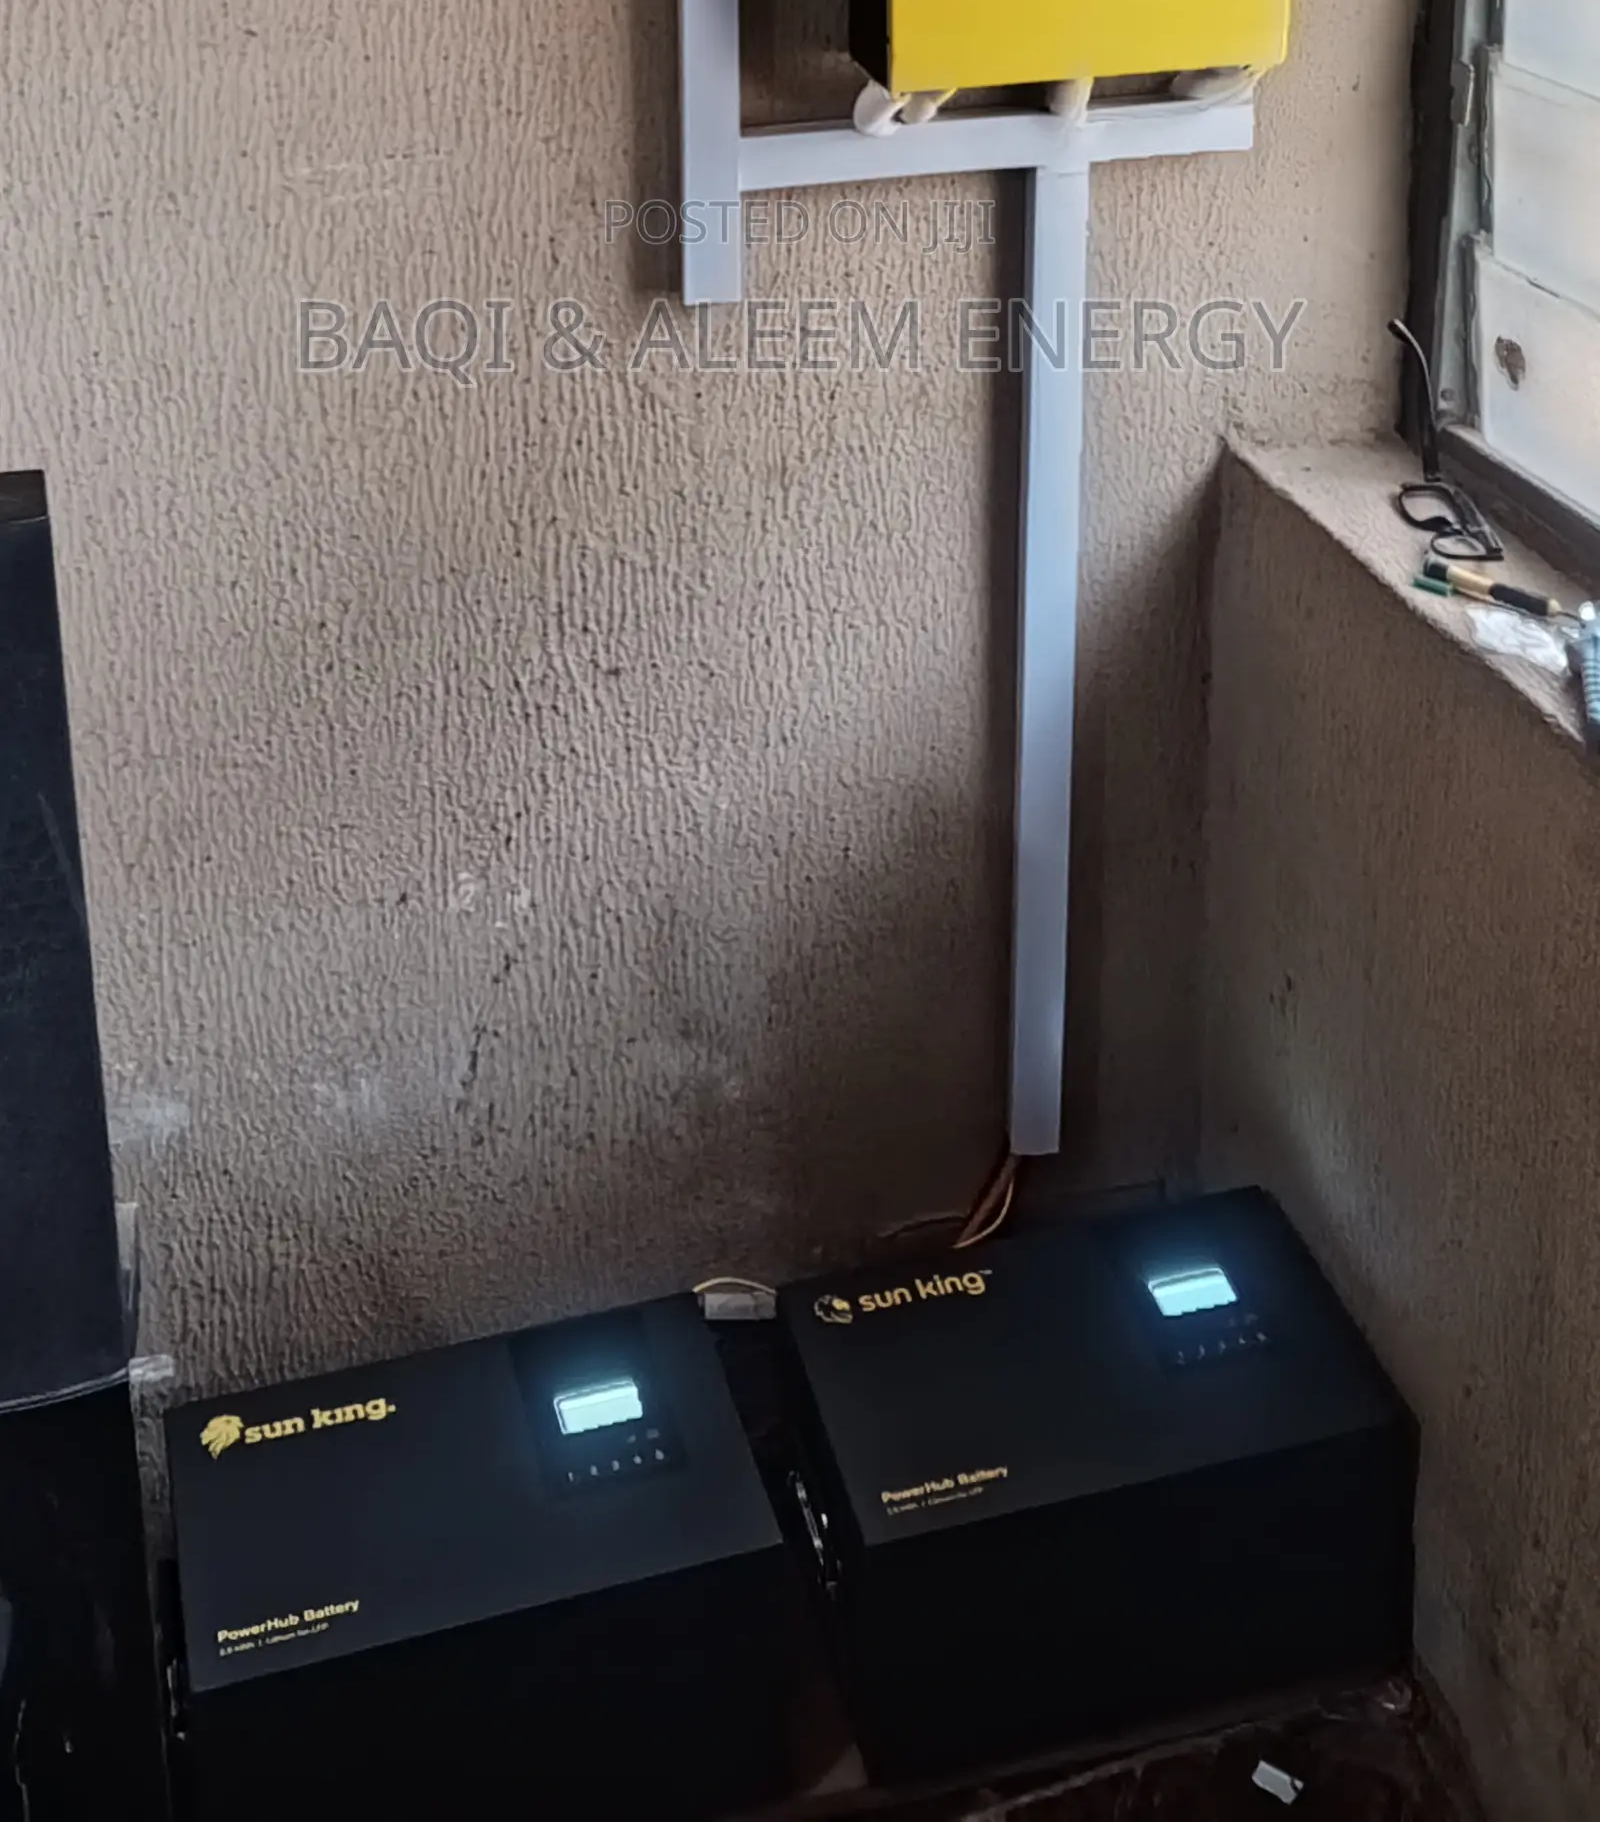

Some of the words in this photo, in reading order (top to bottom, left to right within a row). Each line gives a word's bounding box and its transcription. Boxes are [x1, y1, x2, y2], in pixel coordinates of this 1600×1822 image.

[858, 1287, 913, 1312] sun
[244, 1417, 305, 1444] sun
[217, 1613, 300, 1643] PowerHub
[303, 1599, 360, 1622] Battery
